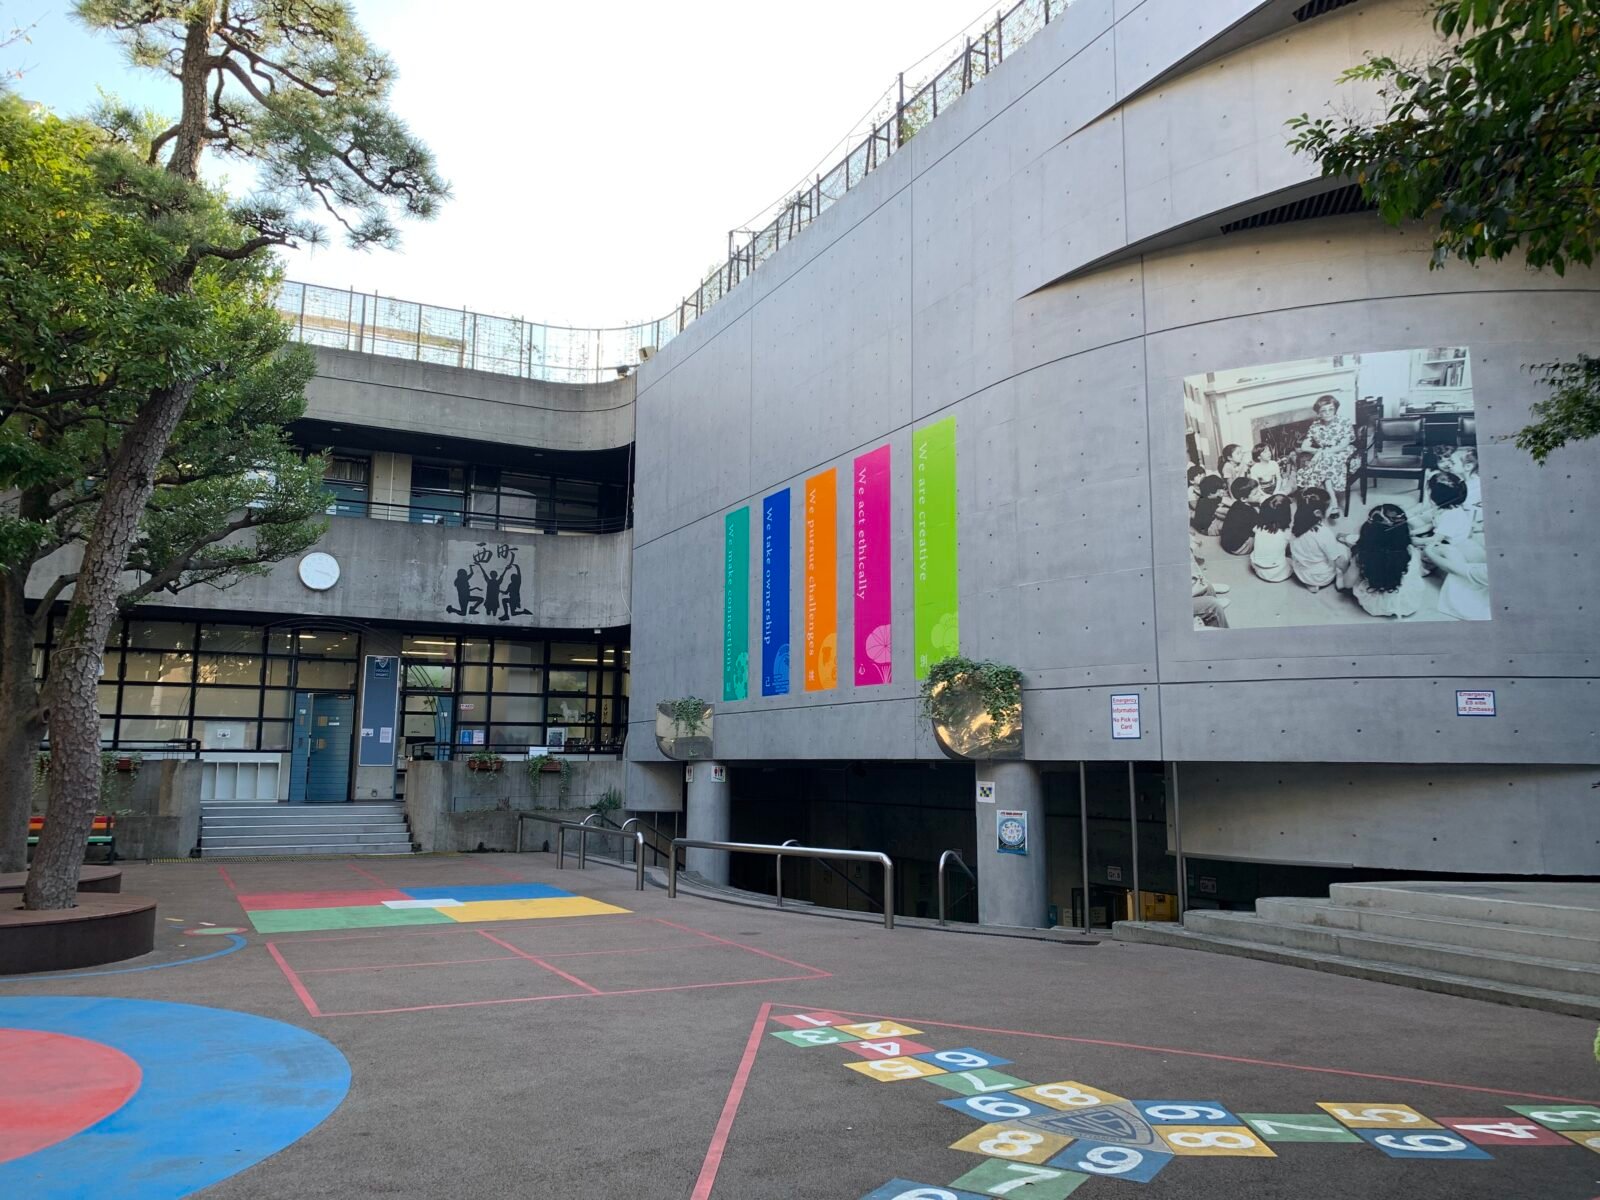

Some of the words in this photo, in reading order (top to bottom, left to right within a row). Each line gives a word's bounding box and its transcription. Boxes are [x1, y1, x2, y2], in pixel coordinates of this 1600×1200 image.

[918, 442, 928, 472] We
[858, 467, 867, 495] We
[918, 478, 926, 505] are
[809, 488, 816, 513] We
[766, 506, 773, 532] We
[858, 501, 867, 525] act
[727, 522, 735, 544] We
[473, 542, 518, 566] 西町
[807, 520, 815, 571] pursue
[918, 511, 929, 582] creative
[856, 529, 868, 600] ethically
[764, 569, 773, 645] ownership
[806, 575, 817, 657] challenges
[792, 1013, 833, 1028] 1
[850, 1021, 902, 1039] 2
[791, 1028, 840, 1045] 3
[859, 1041, 902, 1057] 4
[867, 1059, 924, 1079] 5
[957, 1072, 1017, 1093] 7
[1033, 1083, 1102, 1108] 8
[1250, 1119, 1345, 1135] 7
[1332, 1108, 1423, 1124] 5
[1169, 1131, 1256, 1149] 8
[1453, 1122, 1539, 1139] 4
[978, 1130, 1045, 1157] 8
[986, 1162, 1064, 1195] 7
